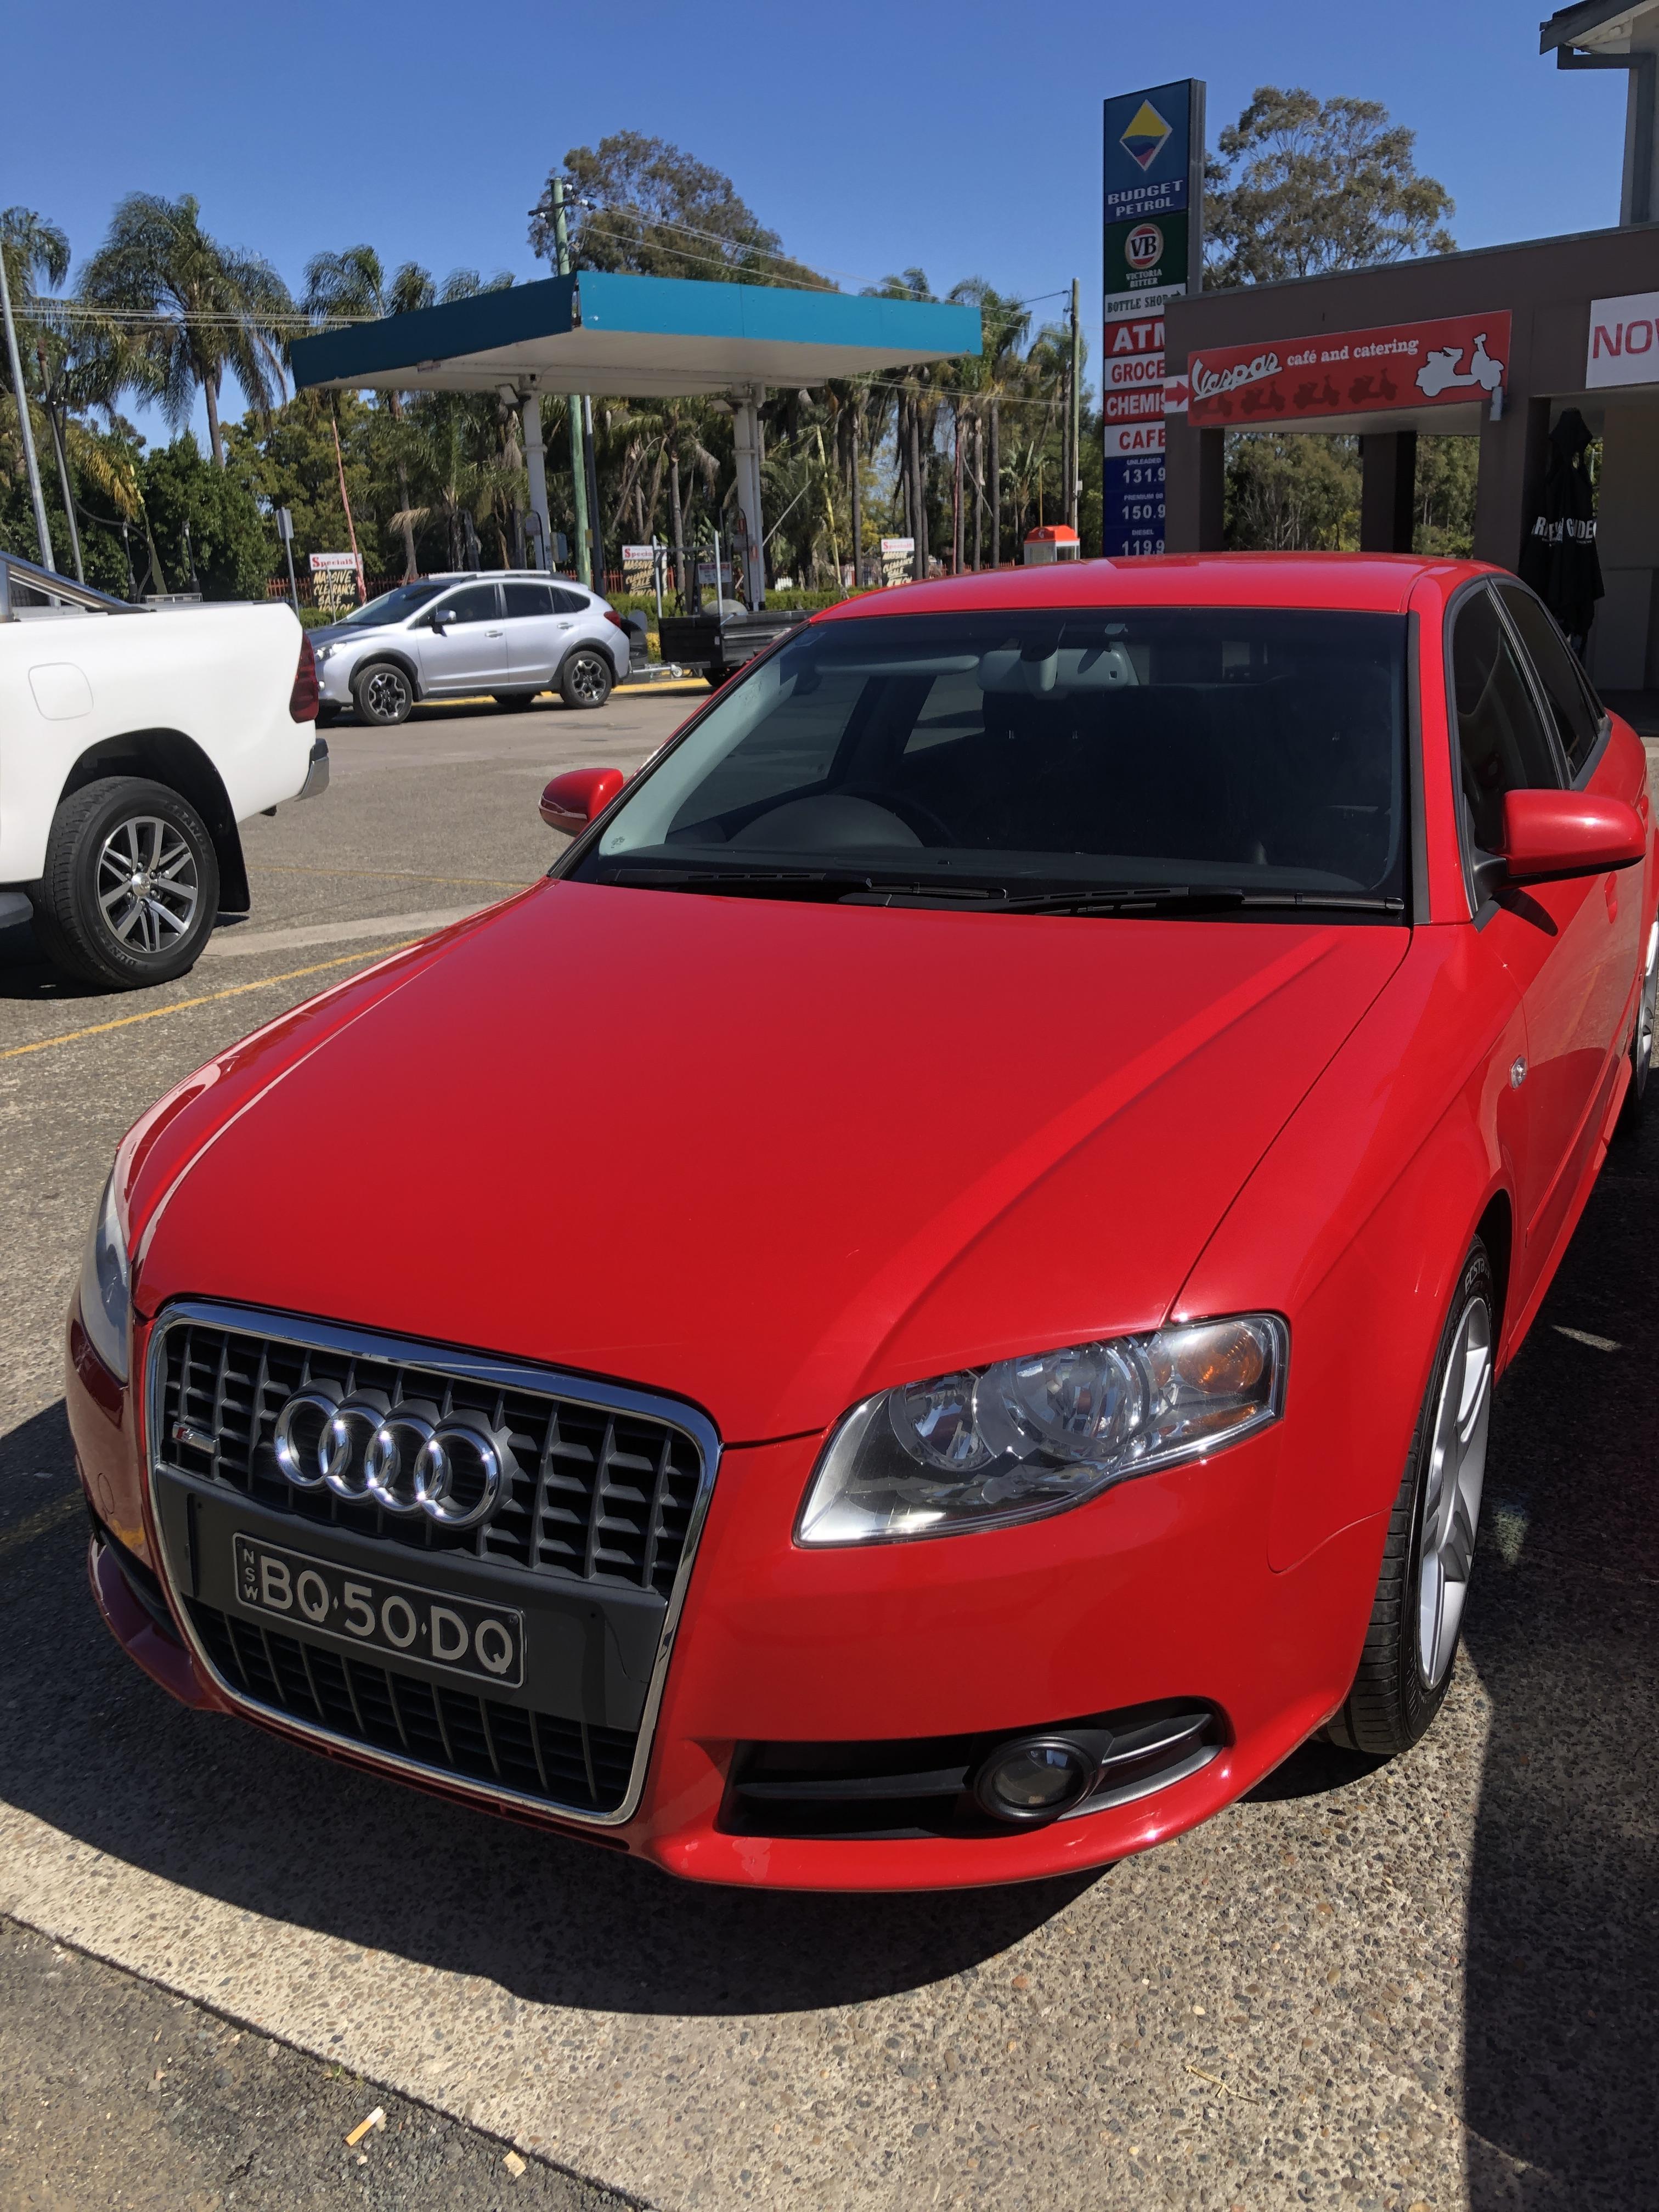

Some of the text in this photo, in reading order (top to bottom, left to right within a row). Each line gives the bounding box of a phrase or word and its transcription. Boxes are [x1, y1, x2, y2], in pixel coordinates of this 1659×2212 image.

[1108, 180, 1183, 205] BUDGET
[1116, 197, 1175, 216] PETROL
[1131, 235, 1156, 257] VB
[1126, 269, 1163, 280] VICTORIA
[1130, 278, 1159, 287] BITTER
[1107, 298, 1142, 313] BOTTLE
[1593, 318, 1659, 359] NO
[1287, 349, 1317, 366] café
[1321, 346, 1348, 362] and
[1353, 337, 1419, 358] catering
[1119, 428, 1165, 450] CAFE
[1123, 467, 1165, 483] 131.9
[1122, 504, 1166, 520] 150.9
[624, 547, 653, 557] Specia
[1122, 540, 1165, 556] 119.9
[623, 560, 654, 570] MASSIVE
[625, 568, 654, 585] CLEARANC
[631, 577, 651, 589] SALE
